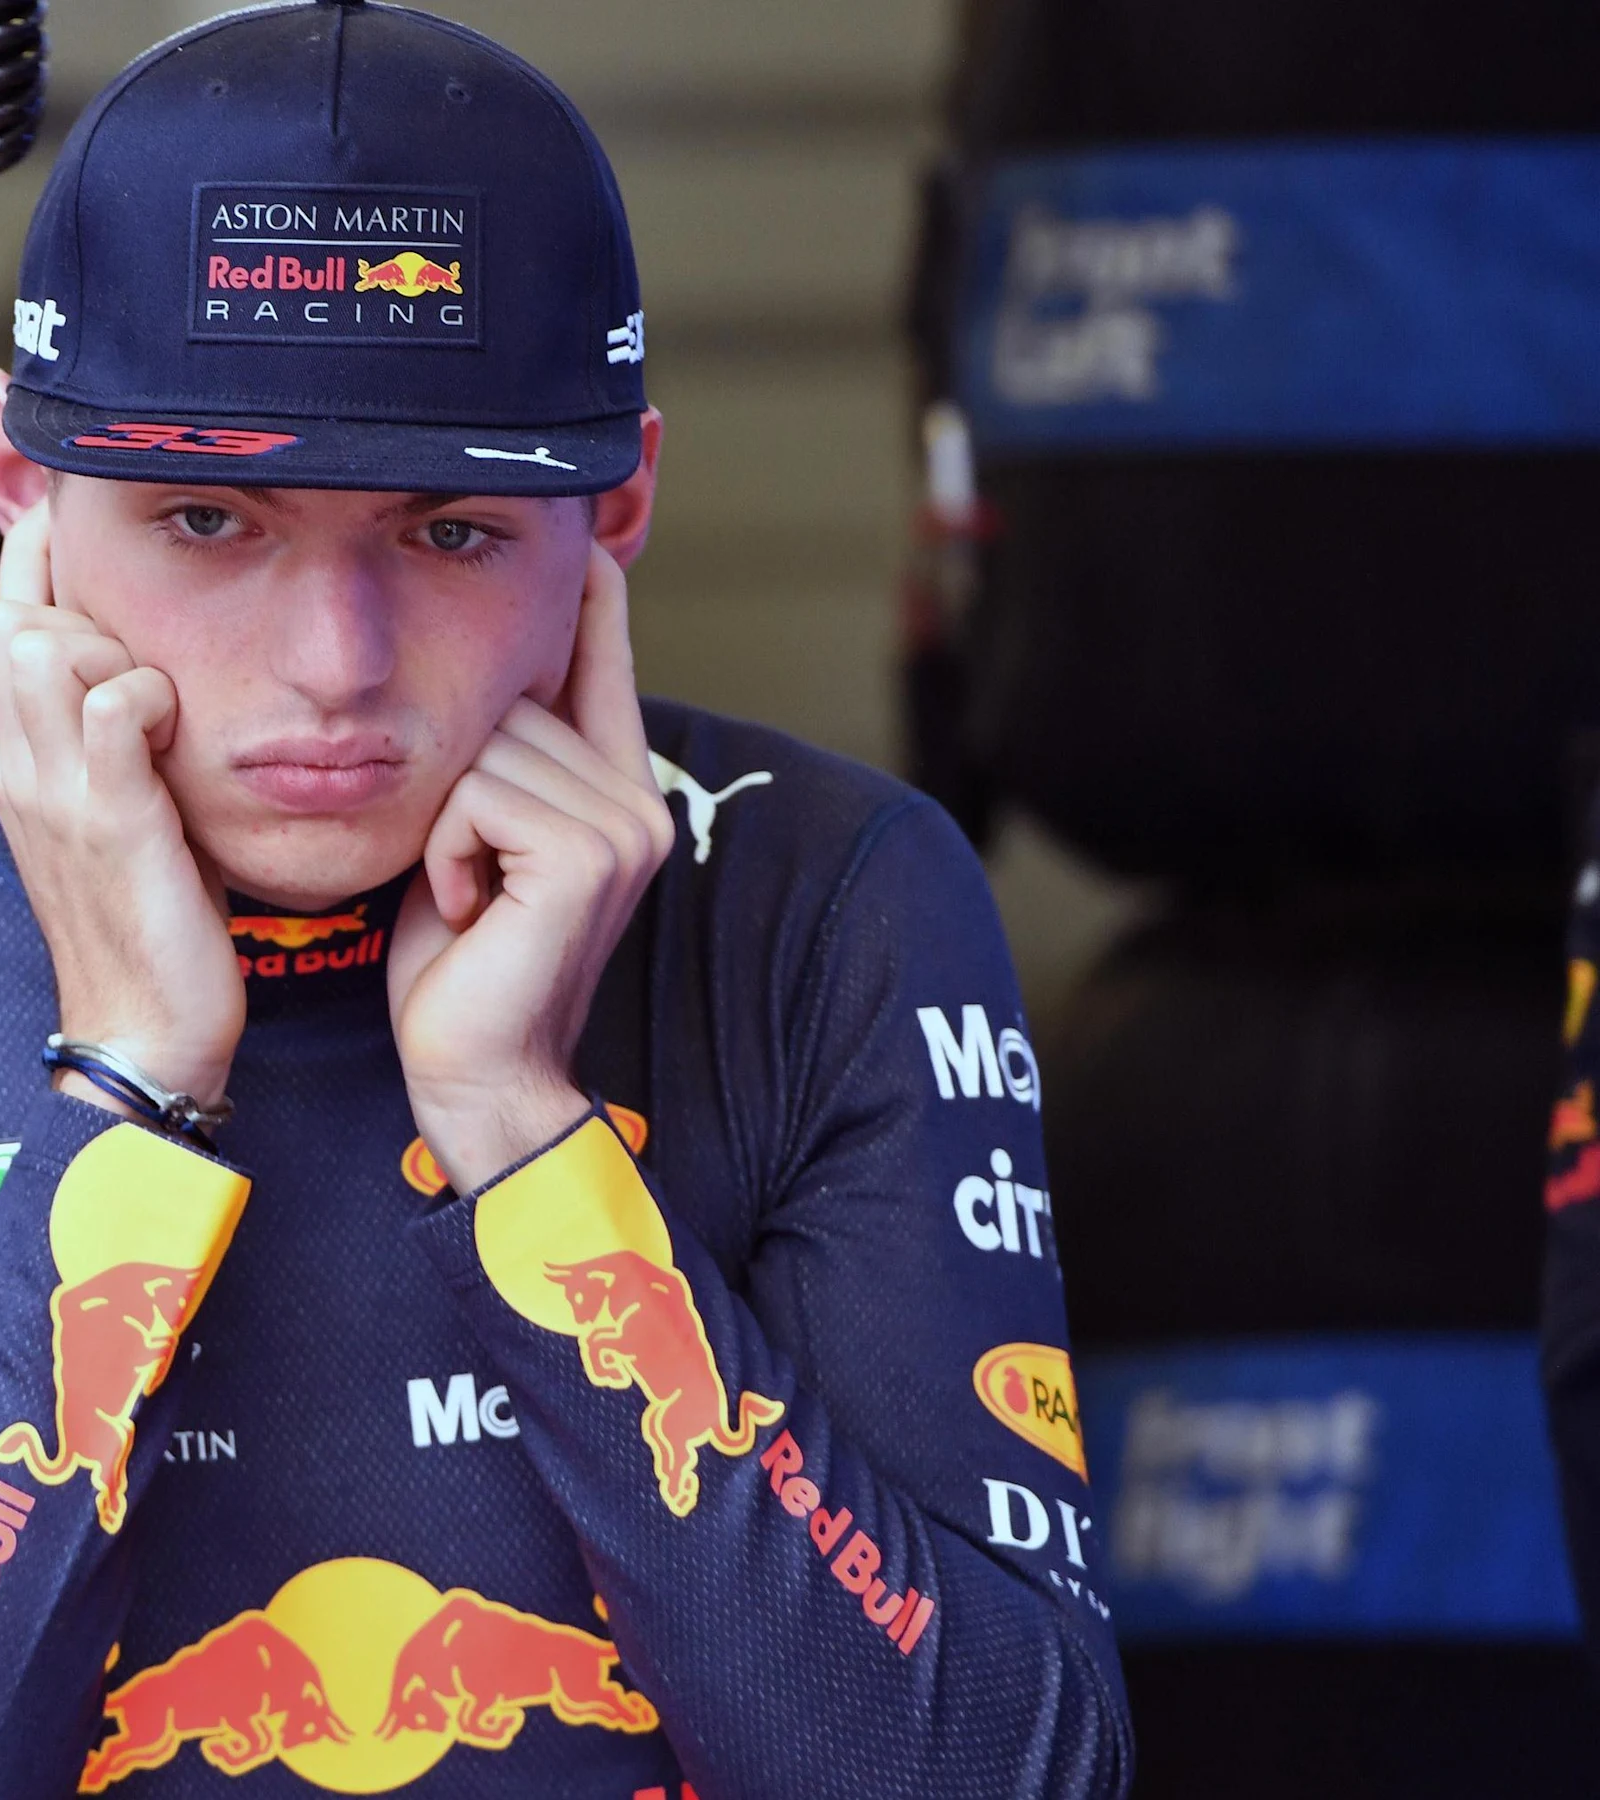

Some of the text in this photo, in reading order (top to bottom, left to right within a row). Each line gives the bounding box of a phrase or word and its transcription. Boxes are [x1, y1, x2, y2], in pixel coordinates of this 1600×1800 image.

[211, 203, 464, 235] ASTON MARTIN
[208, 255, 345, 292] Red Bull
[206, 300, 464, 325] RACING
[70, 422, 300, 457] 33
[1032, 1377, 1080, 1433] RA
[164, 1429, 237, 1462] TIN
[982, 1477, 1092, 1571] DI
[760, 1428, 936, 1657] Red Bull
